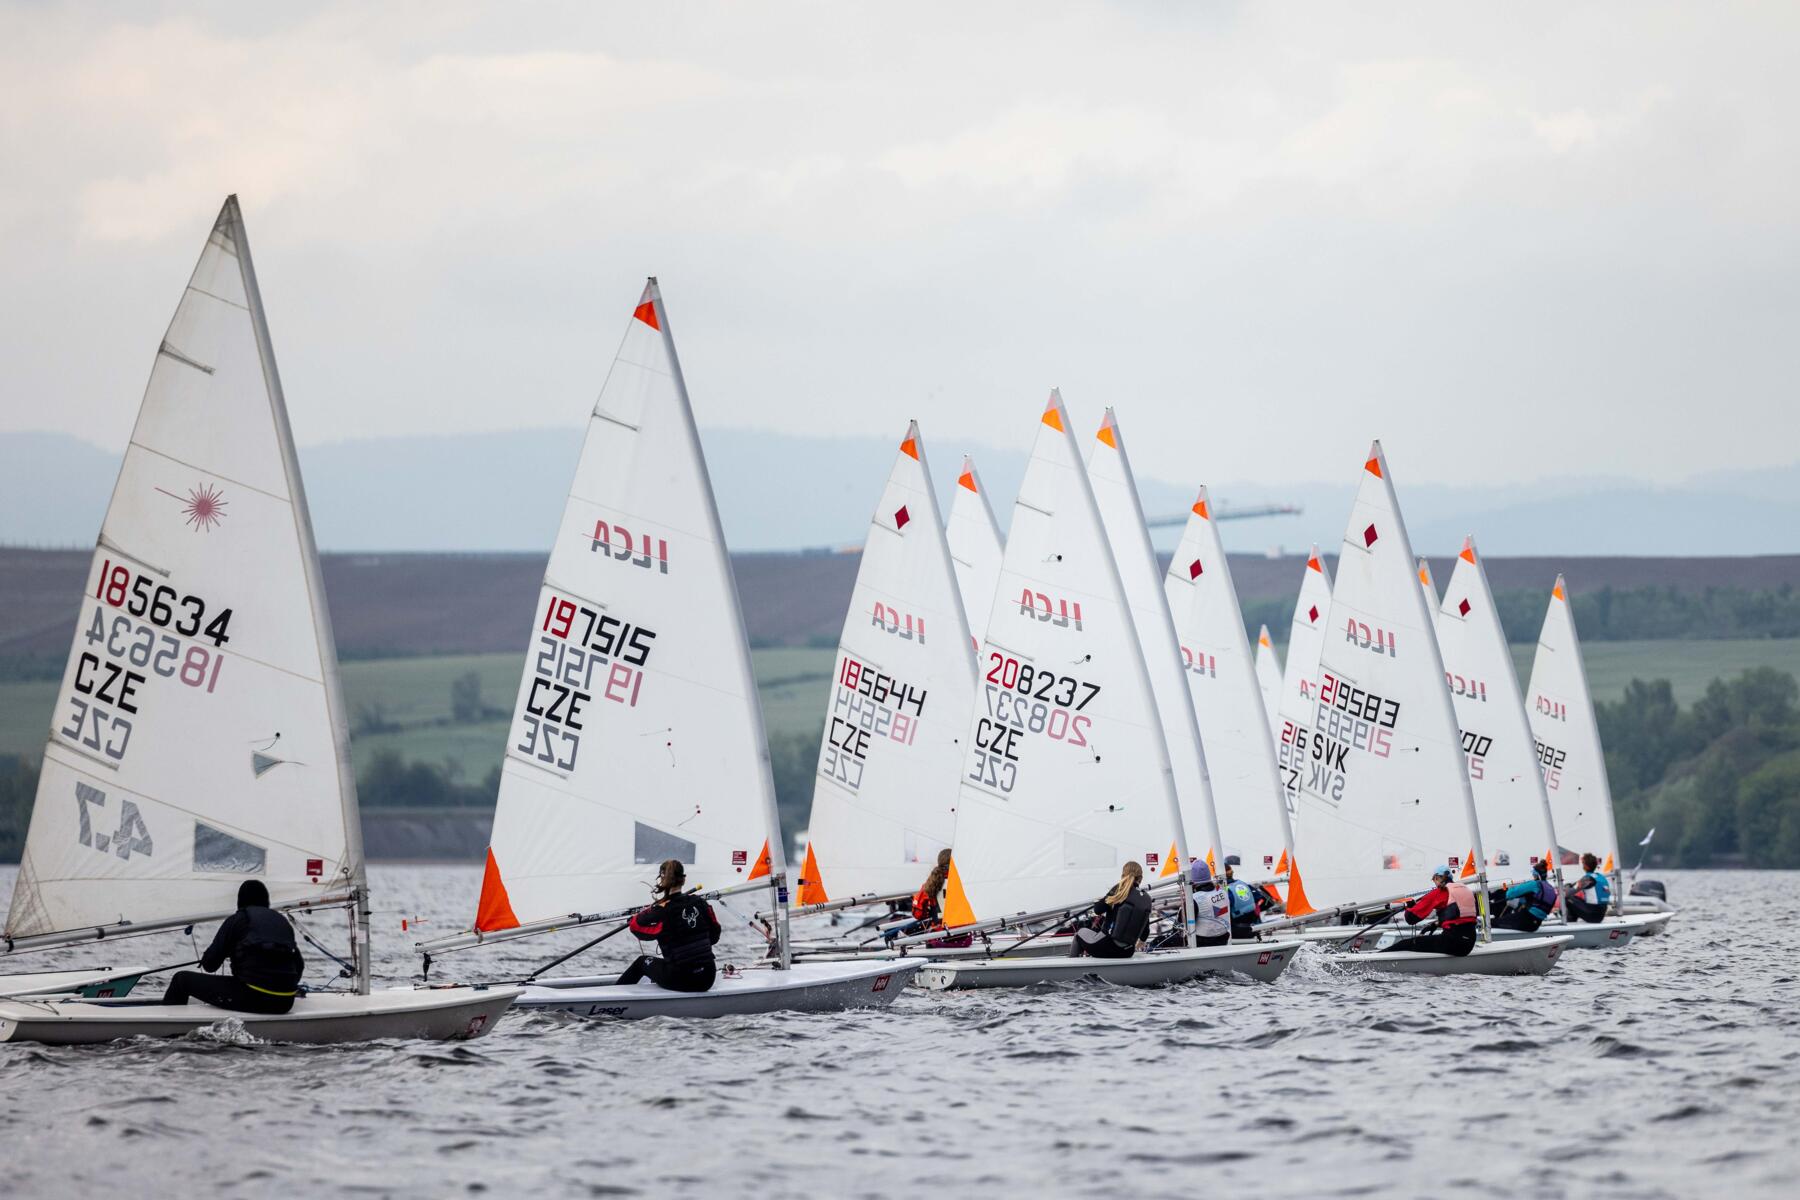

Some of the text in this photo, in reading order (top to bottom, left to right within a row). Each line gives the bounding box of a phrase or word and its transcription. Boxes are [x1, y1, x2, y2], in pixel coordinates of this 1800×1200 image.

[96, 559, 233, 647] 185634
[543, 596, 656, 666] 197515
[75, 652, 146, 714] CZE
[526, 677, 591, 730] CZE
[840, 657, 927, 717] 185644
[986, 652, 1101, 711] 208237
[1320, 673, 1400, 728] 219583
[829, 716, 871, 760] CZE
[975, 718, 1024, 761] CZE
[1312, 733, 1350, 773] SVK
[1460, 729, 1493, 757] 00
[1210, 892, 1225, 904] CZE
[588, 1004, 629, 1016] Laser
